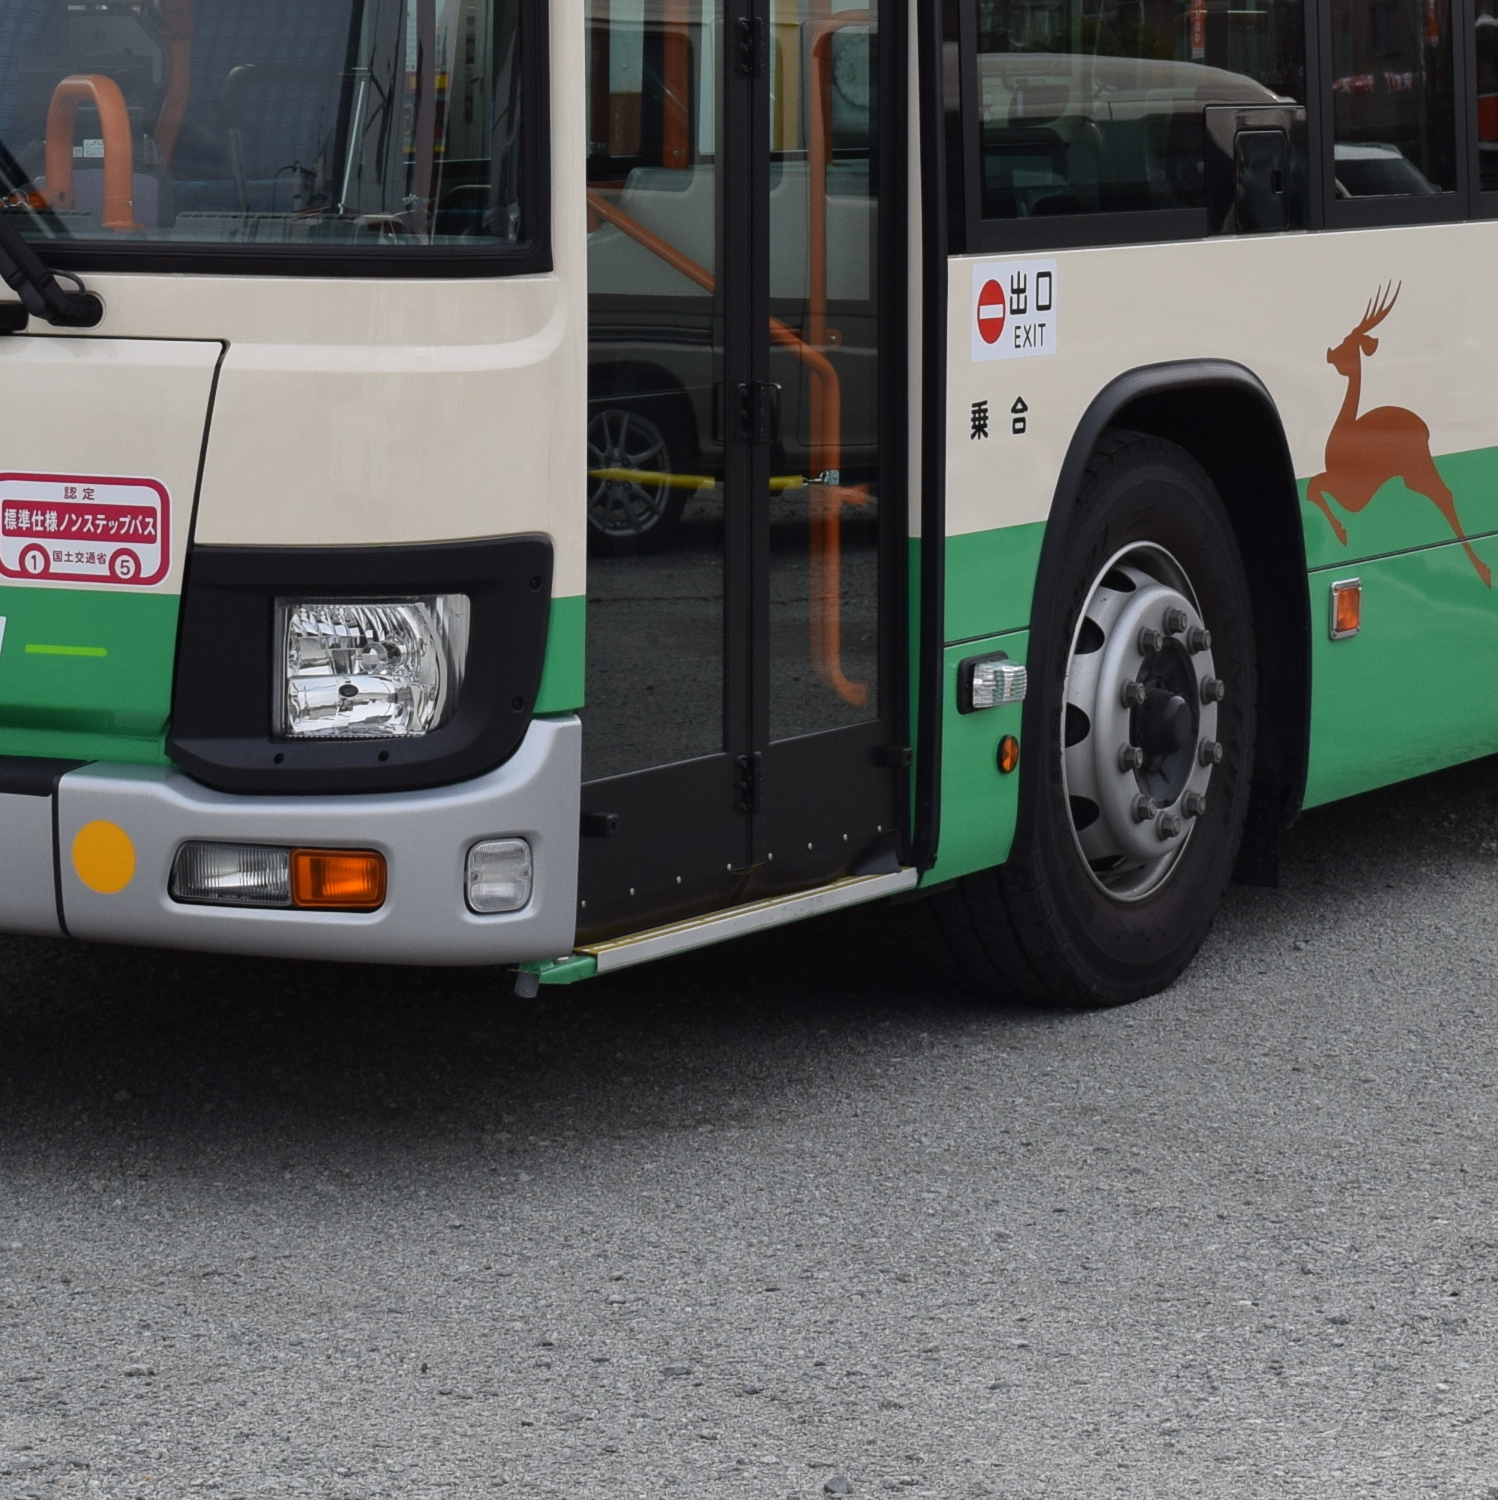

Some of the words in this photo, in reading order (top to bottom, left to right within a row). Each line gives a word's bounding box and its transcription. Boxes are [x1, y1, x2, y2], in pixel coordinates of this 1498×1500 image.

[1009, 270, 1053, 315] 出口
[1014, 323, 1046, 349] EXIT
[970, 395, 1029, 440] 乗合
[64, 486, 95, 500] 認定
[3, 508, 156, 536] 標準仕様ノンステップバス
[52, 550, 107, 565] 国土交通省
[119, 560, 131, 576] 5
